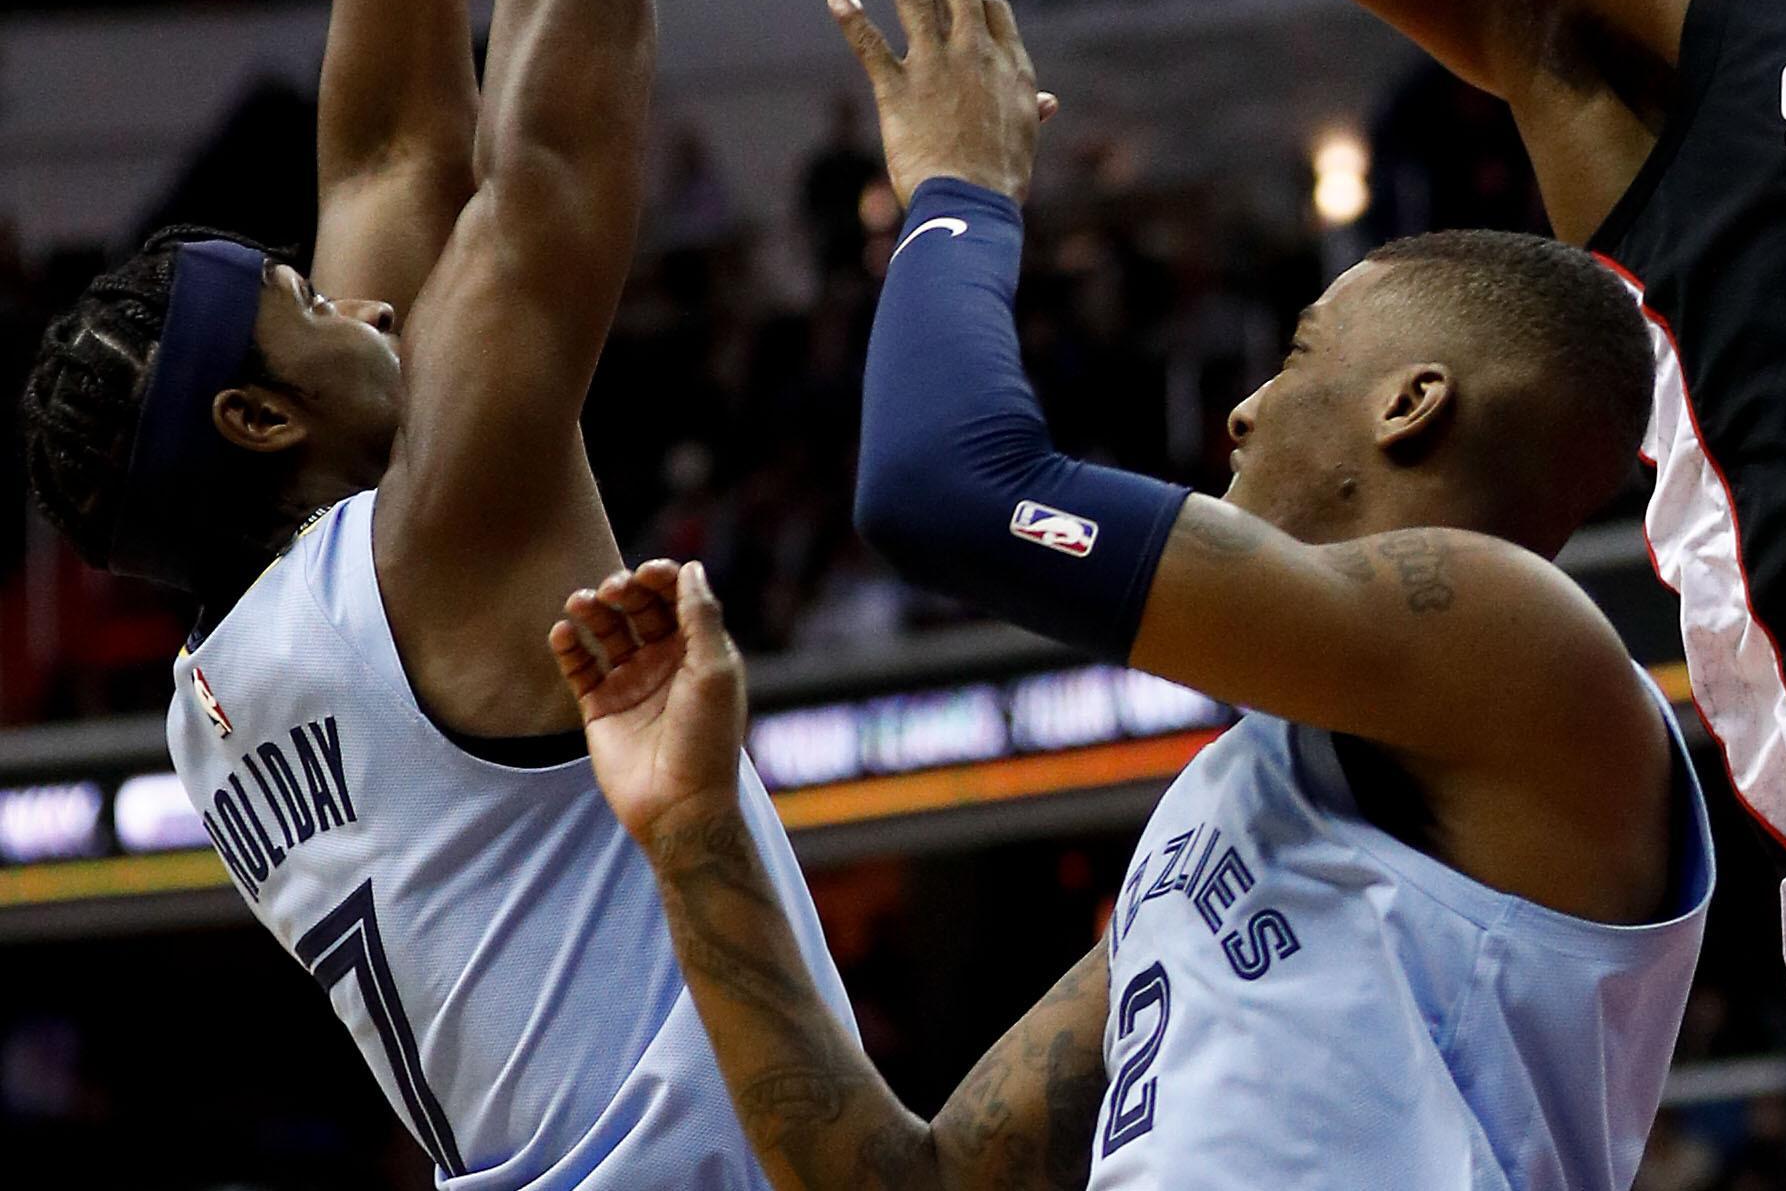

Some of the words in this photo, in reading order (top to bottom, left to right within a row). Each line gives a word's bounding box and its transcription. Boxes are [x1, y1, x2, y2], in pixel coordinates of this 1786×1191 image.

[202, 714, 358, 905] HOLIDAY
[294, 877, 467, 1179] 7
[1102, 960, 1171, 1161] 2
